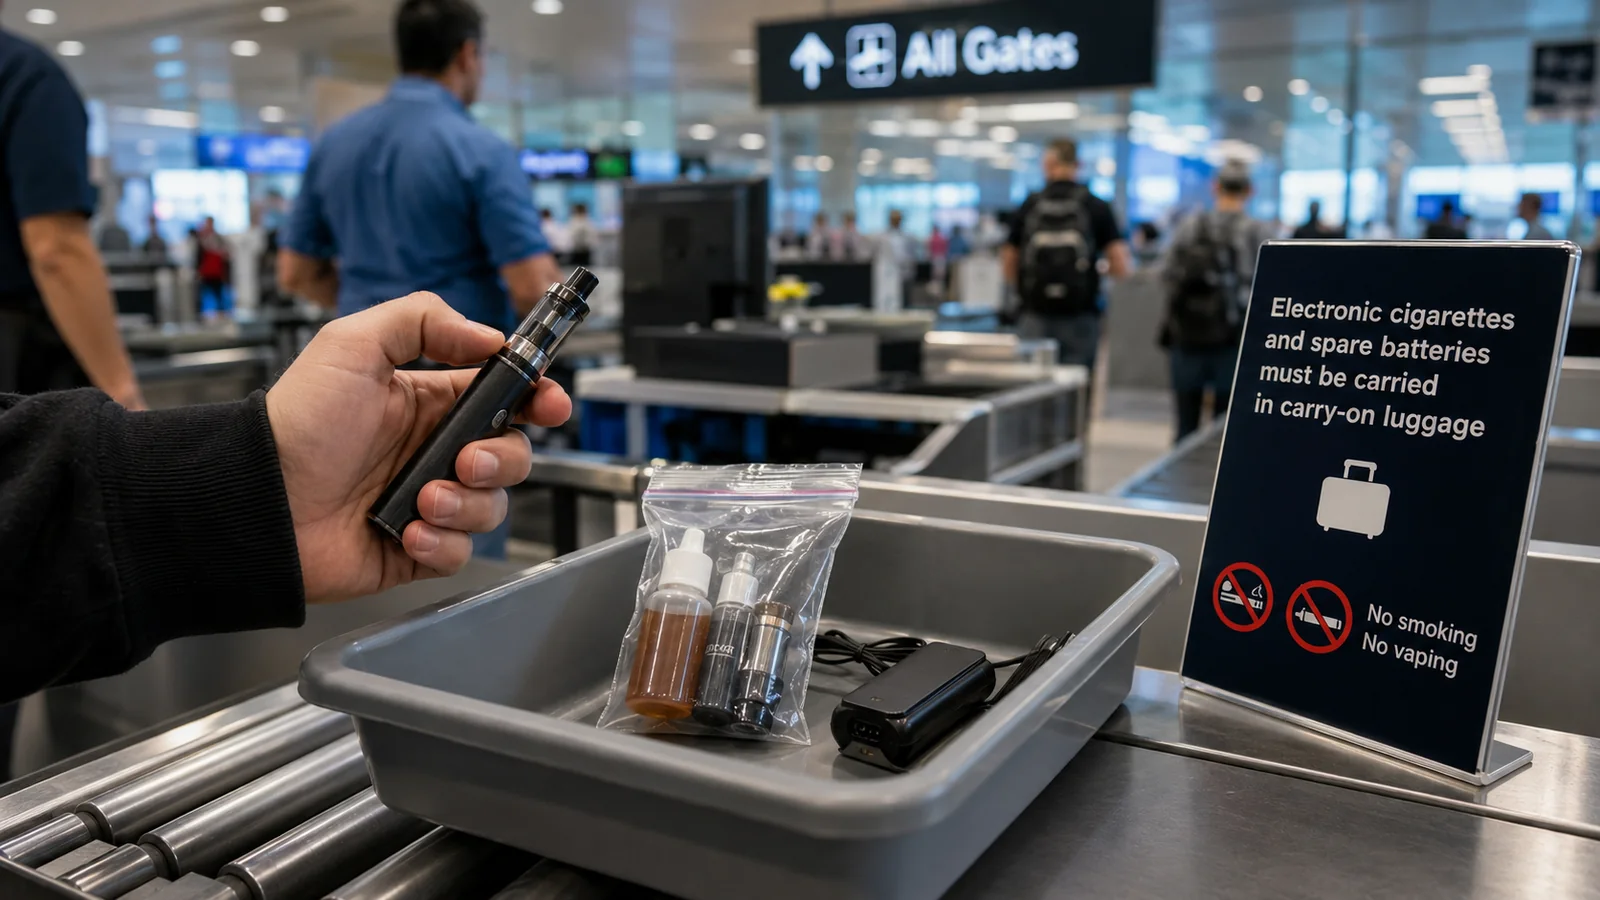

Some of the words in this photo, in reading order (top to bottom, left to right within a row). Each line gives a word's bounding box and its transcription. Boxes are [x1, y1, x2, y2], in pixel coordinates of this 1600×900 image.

[902, 28, 957, 79] All
[962, 26, 1079, 75] Gates
[1270, 297, 1383, 323] Electronic
[1389, 302, 1516, 331] cigarettes
[1264, 329, 1306, 351] and
[1310, 336, 1373, 358] spare
[1380, 335, 1491, 365] batteries
[1259, 365, 1313, 385] must
[1318, 364, 1347, 388] be
[1354, 371, 1440, 396] carried
[1254, 391, 1274, 415] in
[1280, 400, 1376, 426] carry-on
[1383, 404, 1486, 441] luggage
[1367, 603, 1393, 626] No
[1397, 616, 1478, 653] smoking
[1362, 631, 1389, 655] No
[1394, 644, 1459, 679] vaping
